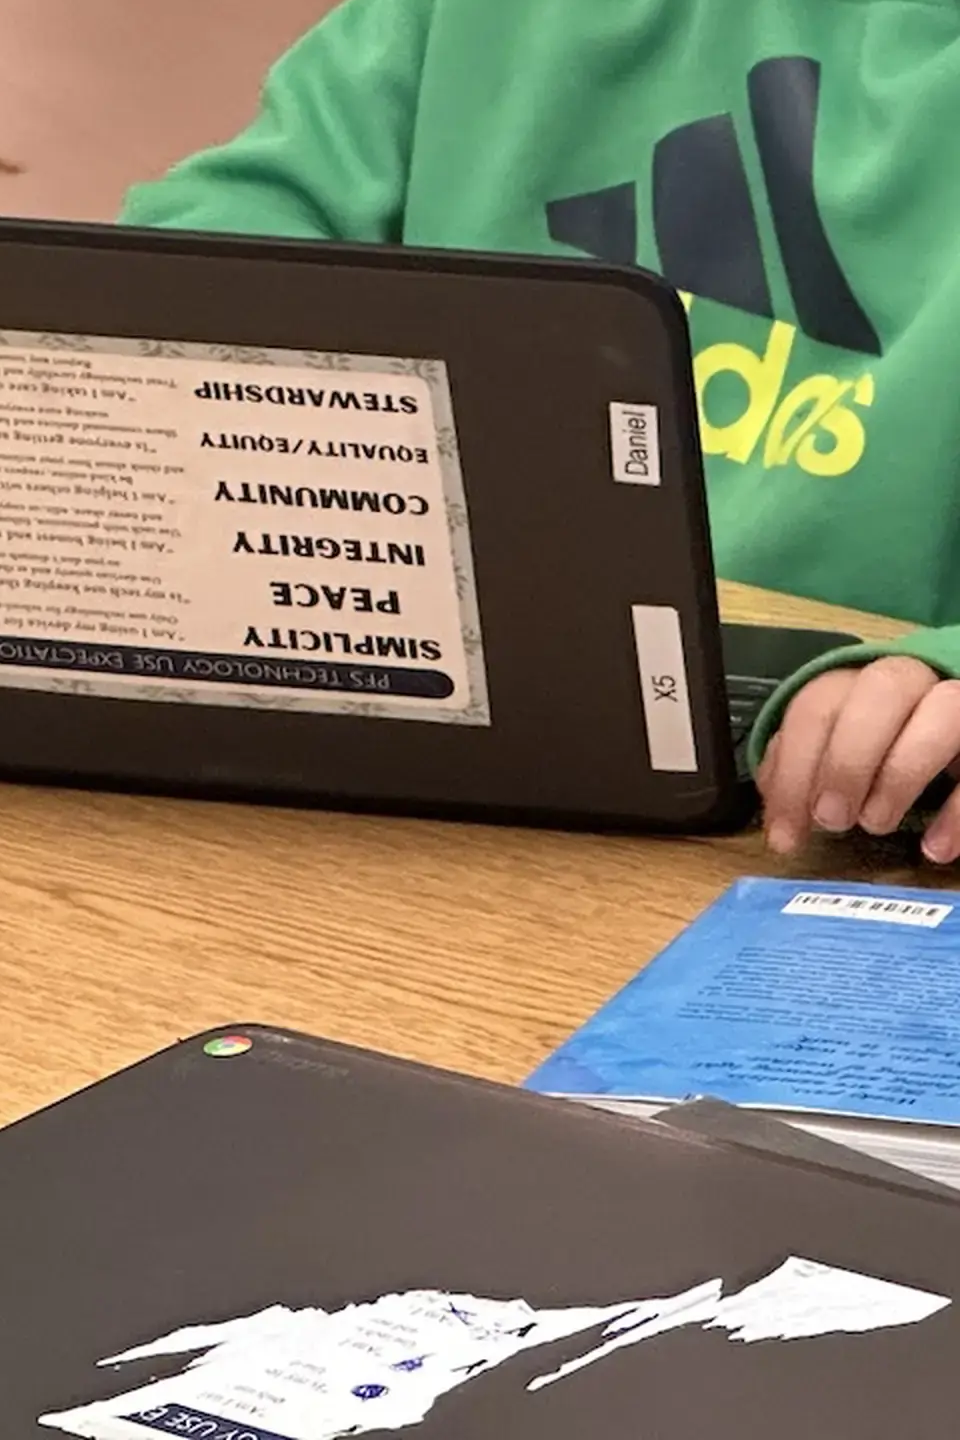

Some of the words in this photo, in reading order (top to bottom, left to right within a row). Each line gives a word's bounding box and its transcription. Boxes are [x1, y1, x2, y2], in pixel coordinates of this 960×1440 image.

[7, 381, 38, 392] care
[39, 381, 88, 398] taking
[90, 387, 98, 399] I
[193, 380, 418, 414] STEWARDSHIP
[12, 428, 65, 444] getting
[67, 435, 132, 450] everyone
[625, 410, 649, 476] Daniel
[199, 431, 429, 464] EQUALITY/EQUITY
[24, 481, 71, 496] others
[72, 483, 129, 501] helping
[130, 490, 139, 502] I
[213, 480, 429, 516] COMMUNITY
[5, 529, 32, 542] and
[35, 531, 84, 547] honest
[85, 533, 128, 551] being
[129, 539, 137, 551] I
[232, 530, 425, 567] INTEGRITY
[22, 577, 81, 595] keeping
[82, 583, 107, 594] use
[108, 586, 141, 599] tech
[142, 586, 166, 599] my
[268, 580, 401, 615] PEACE
[3, 616, 24, 628] for
[26, 614, 72, 632] device
[74, 619, 96, 631] my
[97, 621, 139, 634] using
[141, 626, 147, 638] I
[242, 625, 442, 661] SIMPLICITY
[135, 653, 173, 671] USE
[183, 659, 338, 685] TECHNOLOGY
[349, 671, 389, 689] PFS
[652, 675, 677, 703] X5
[165, 1412, 219, 1436] USE
